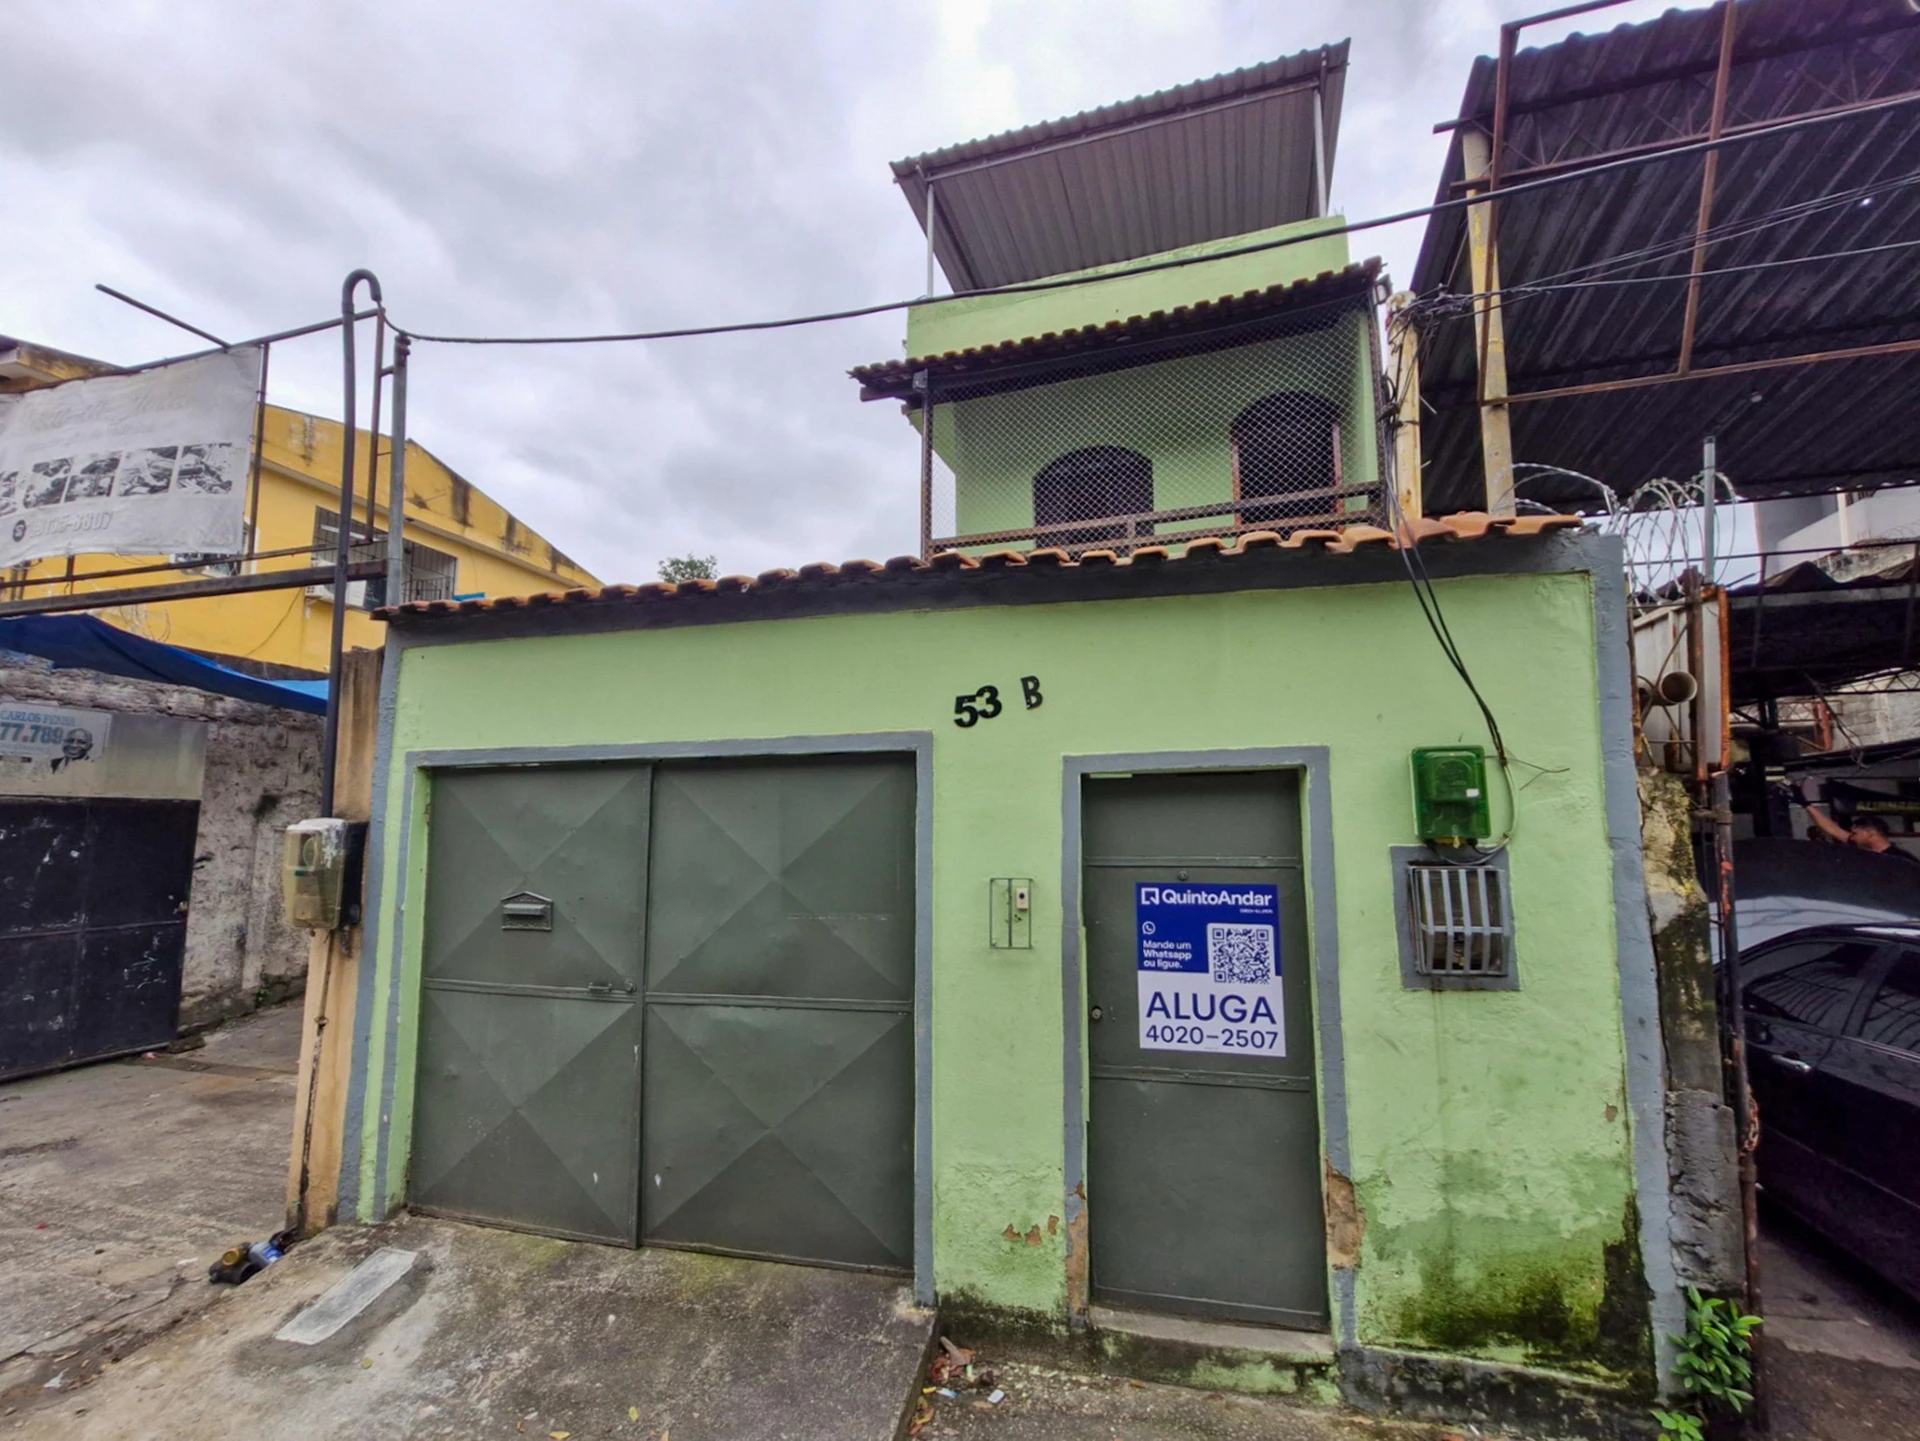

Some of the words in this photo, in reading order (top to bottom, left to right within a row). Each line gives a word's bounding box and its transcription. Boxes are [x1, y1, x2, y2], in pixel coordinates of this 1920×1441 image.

[953, 685, 1002, 728] 53
[1020, 675, 1043, 710] B
[0, 711, 41, 723] CARLOS
[0, 722, 63, 743] 77.789
[1162, 889, 1273, 907] QuintoAndar
[1143, 939, 1174, 950] Mande
[1176, 942, 1192, 950] um
[1143, 949, 1192, 961] Whatsapp
[1143, 960, 1156, 968] ou
[1157, 958, 1183, 970] ligue.
[1145, 991, 1277, 1025] ALUGA
[1145, 1024, 1279, 1050] 4020-2507
